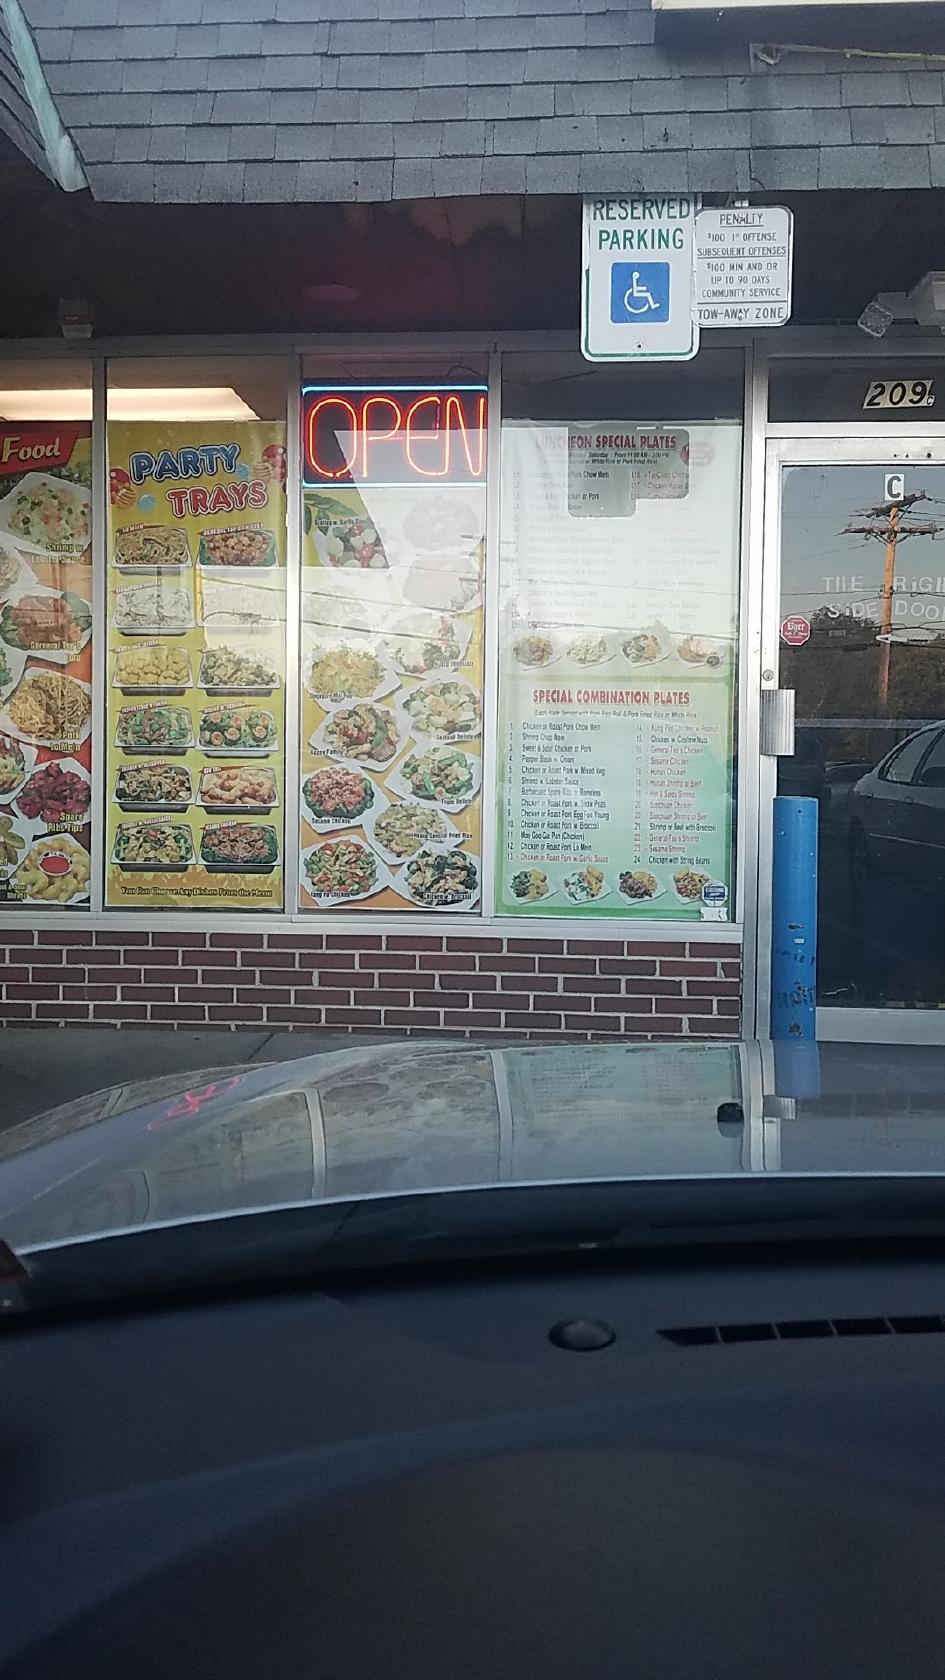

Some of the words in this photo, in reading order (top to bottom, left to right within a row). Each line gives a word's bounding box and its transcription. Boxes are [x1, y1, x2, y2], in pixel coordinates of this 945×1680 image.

[592, 198, 690, 220] RESERVED
[720, 213, 763, 225] PENALTY
[598, 228, 684, 250] PARKING
[707, 232, 725, 242] $100
[742, 232, 776, 242] OFFENSE
[697, 248, 746, 256] SUBSEQUENT
[748, 246, 786, 256] OFFENSES
[706, 262, 725, 272] $100
[729, 263, 743, 271] MIN
[746, 262, 762, 270] AND
[766, 262, 778, 270] OR
[711, 276, 722, 284] UP
[726, 276, 734, 284] TO
[738, 276, 748, 284] 90
[752, 276, 770, 284] DAYS
[702, 288, 746, 298] COMMUNITY
[749, 288, 780, 296] SERVICE
[698, 308, 750, 320] TOW-AWAY
[755, 307, 784, 318] ZONE
[308, 396, 486, 478] OPEN
[596, 435, 636, 448] SPECIAL
[640, 436, 676, 448] PLATES
[1, 436, 60, 463] Food
[129, 443, 242, 486] PARTY
[886, 475, 902, 500] C
[166, 480, 268, 518] TRAYS
[46, 543, 74, 553] Shrimp
[822, 576, 865, 592] THE
[533, 690, 572, 704] SPECIAL
[576, 690, 650, 704] COMBINATION
[654, 691, 690, 704] PLATES
[60, 812, 84, 822] Spare
[67, 824, 84, 832] Tips
